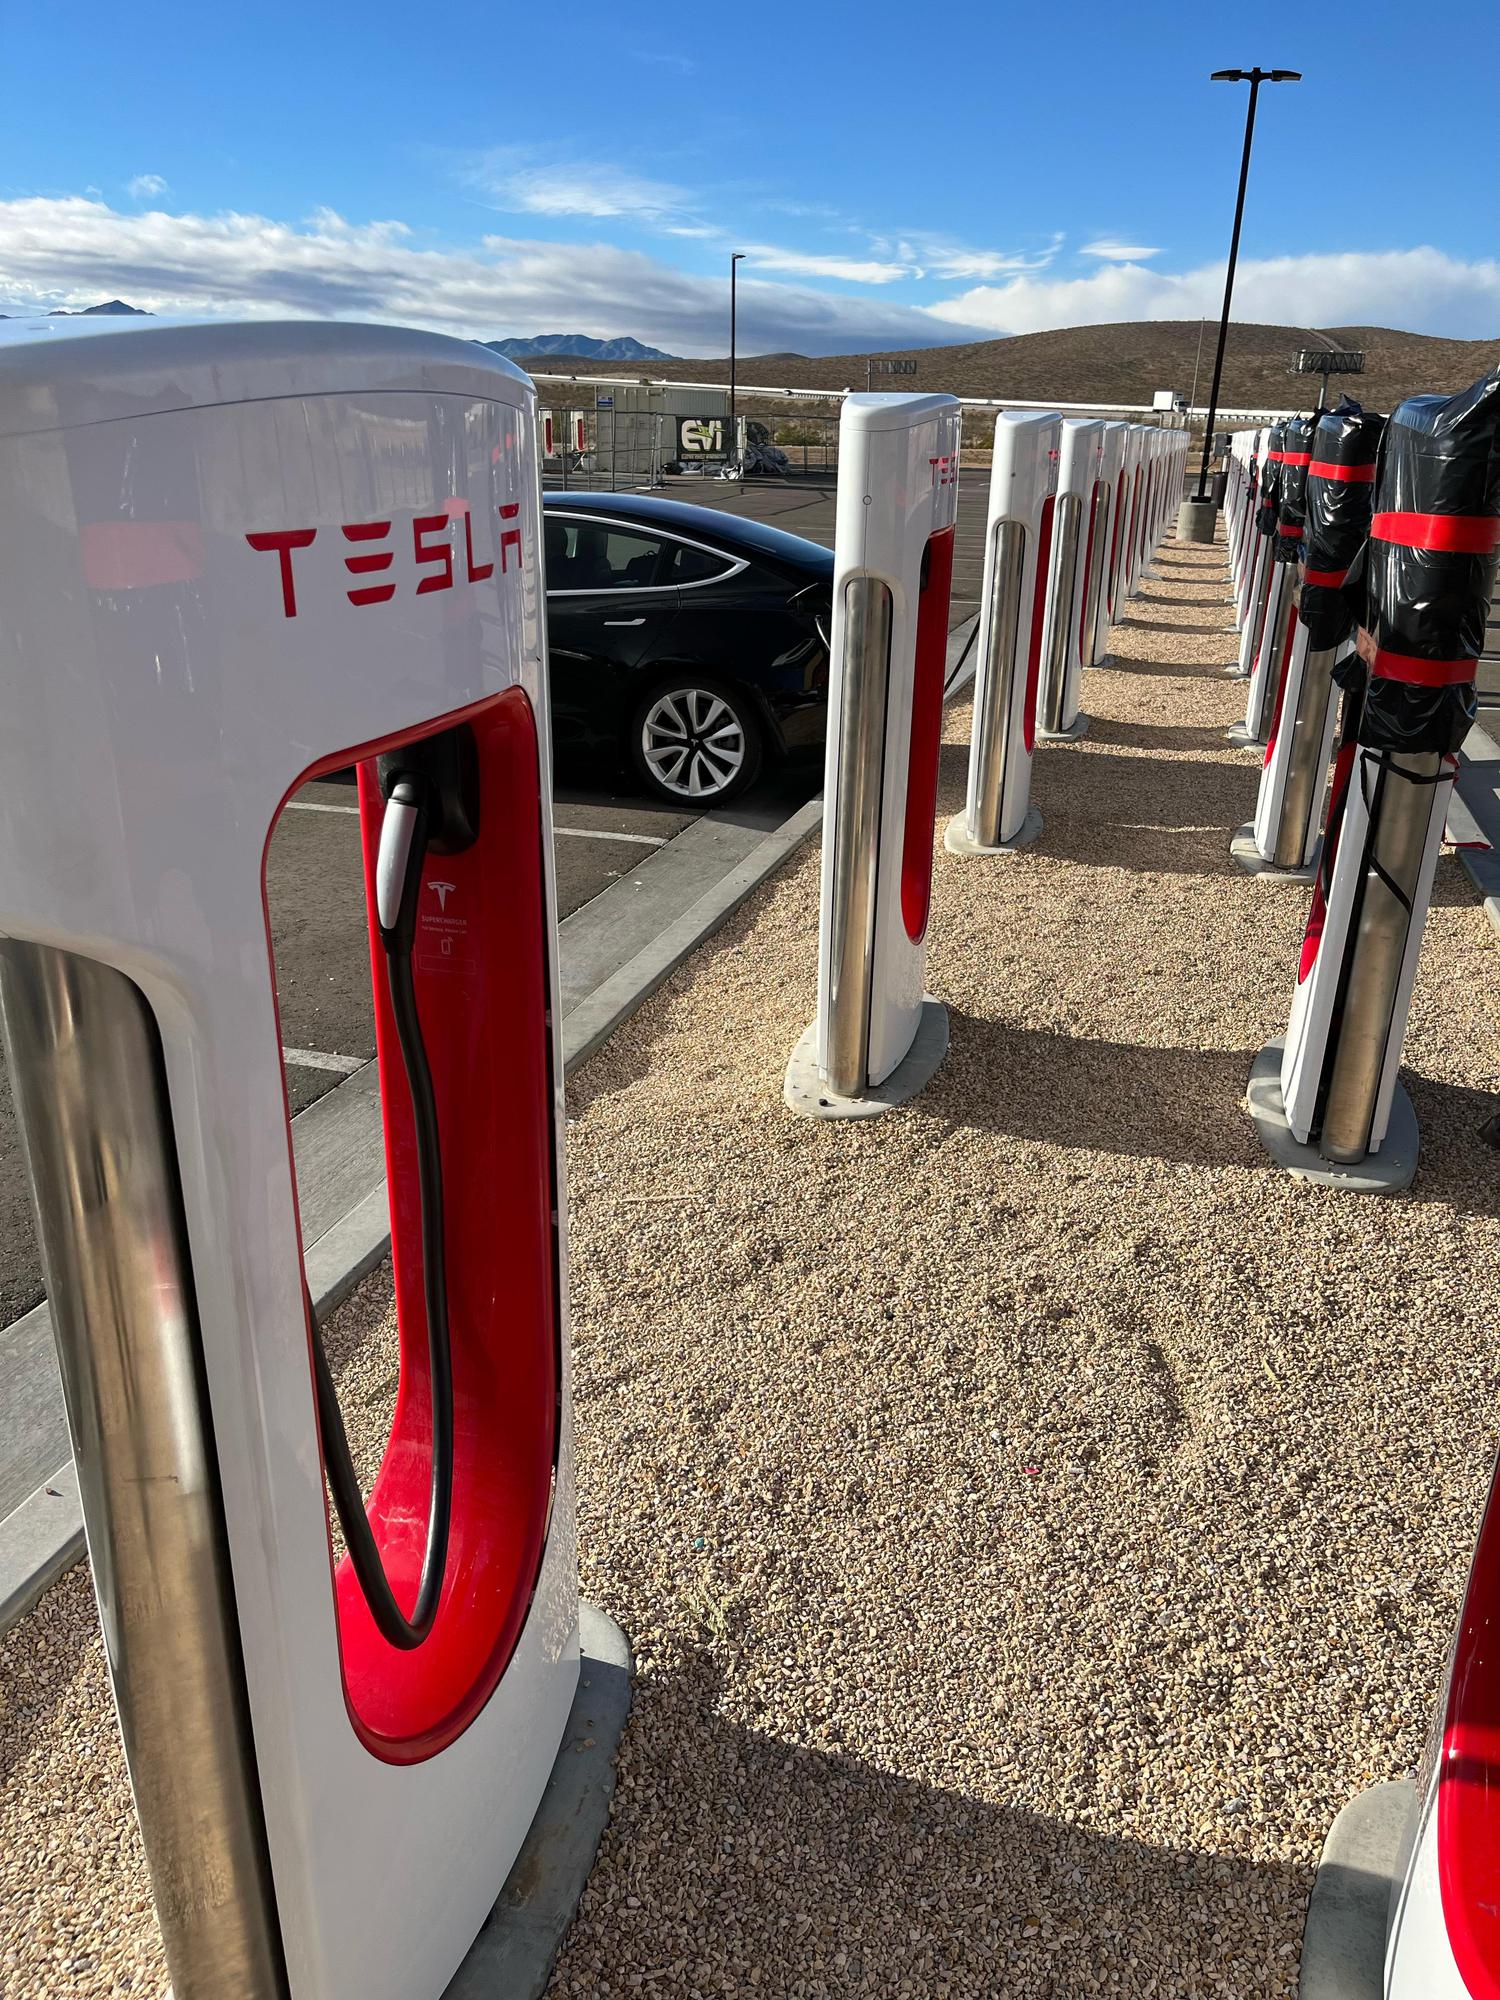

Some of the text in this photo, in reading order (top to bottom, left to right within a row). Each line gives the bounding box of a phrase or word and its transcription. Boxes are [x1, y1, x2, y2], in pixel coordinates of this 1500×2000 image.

[681, 420, 723, 452] EVI
[929, 457, 959, 486] TES
[245, 502, 523, 618] TESLA
